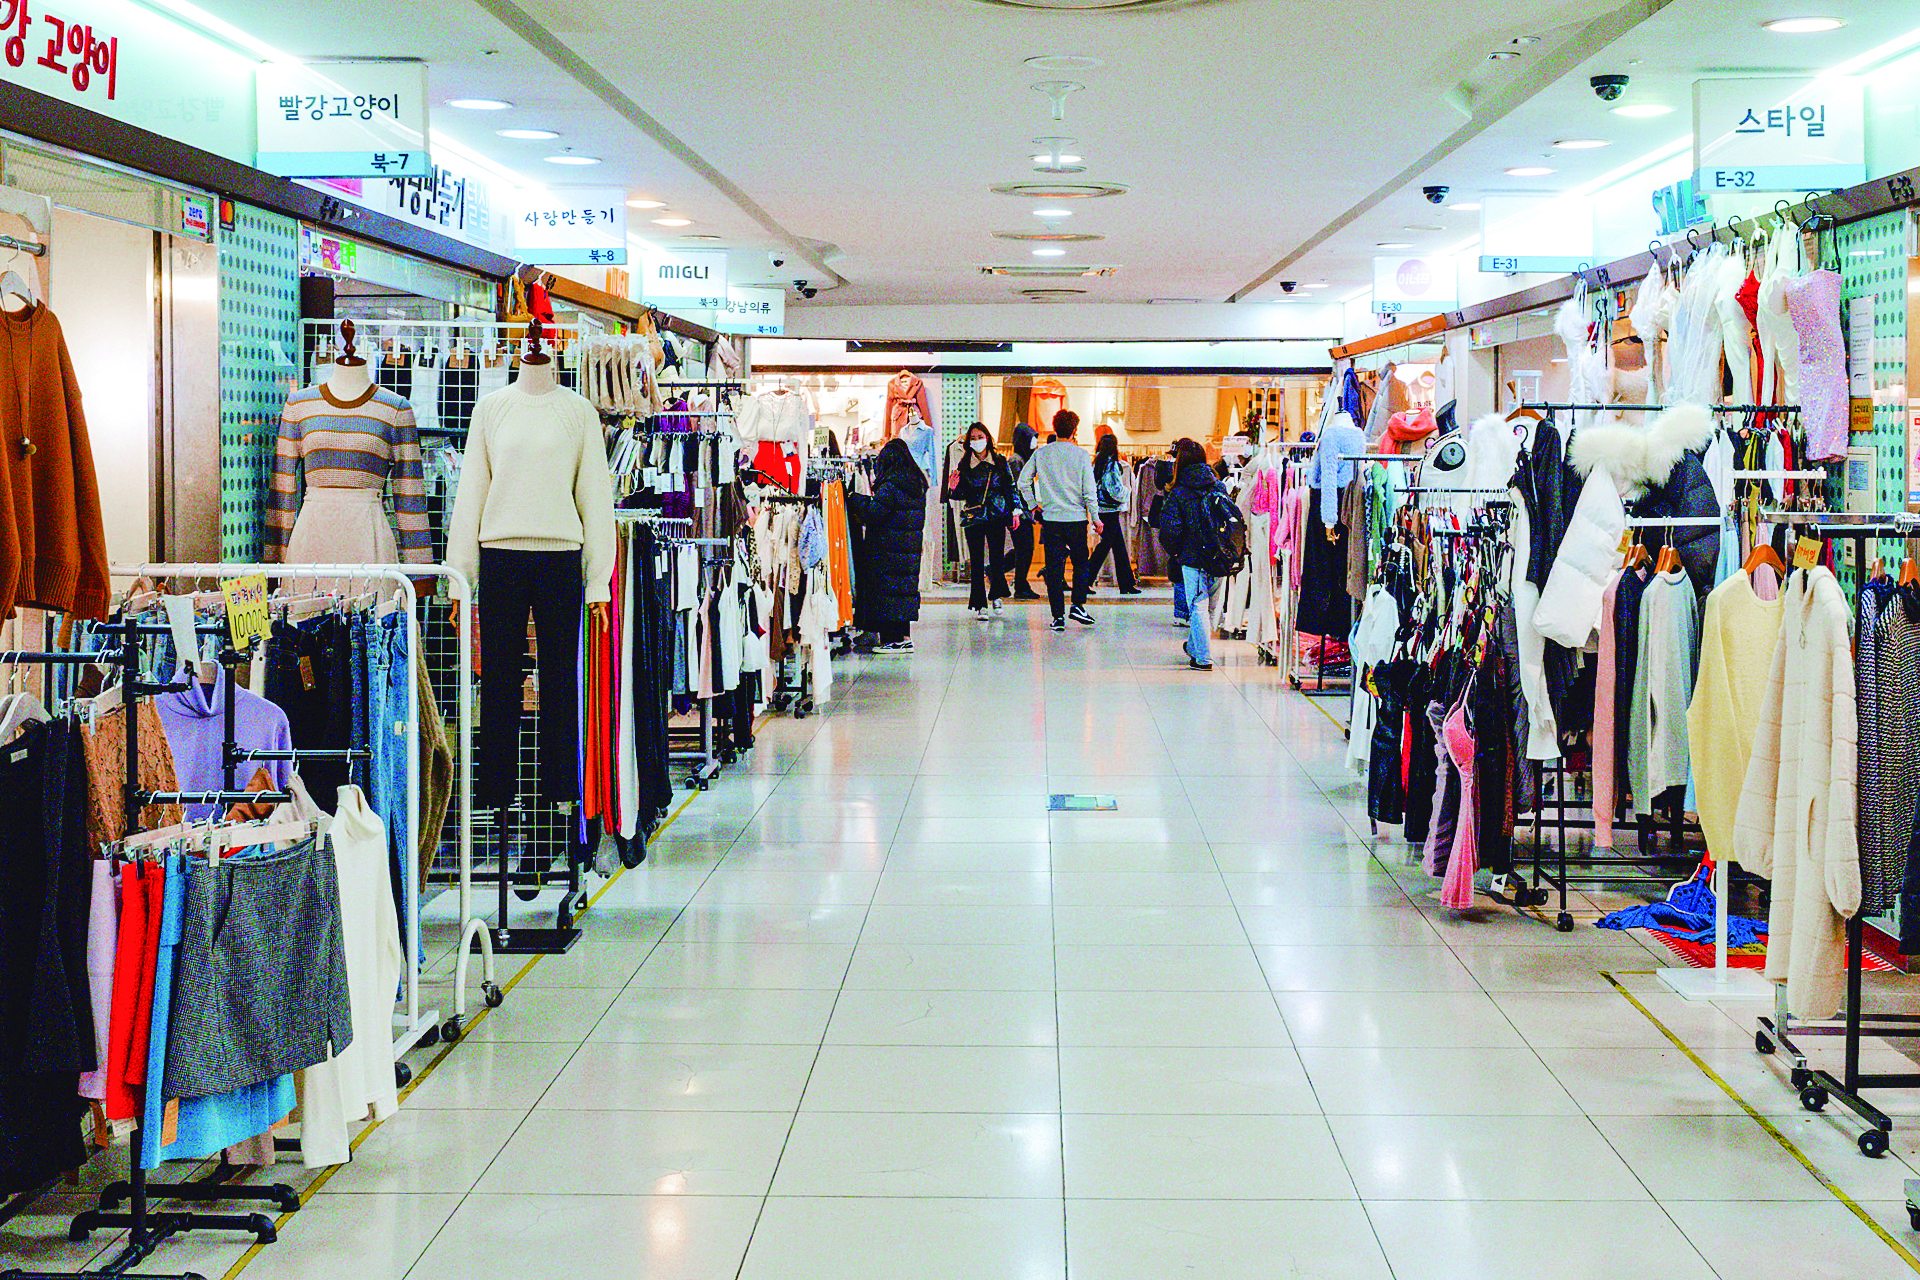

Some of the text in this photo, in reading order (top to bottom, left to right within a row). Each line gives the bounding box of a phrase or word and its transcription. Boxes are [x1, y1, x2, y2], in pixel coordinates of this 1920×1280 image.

[38, 15, 117, 100] 고양이
[279, 94, 399, 121] 빨강고양이
[1735, 105, 1825, 138] 스타일
[371, 153, 409, 173] 북-7
[1716, 171, 1755, 188] E-32
[525, 208, 615, 226] 사랑만들기
[589, 249, 615, 263] 북-8
[1493, 258, 1518, 269] E-31
[659, 265, 709, 279] MIGLI
[698, 297, 718, 308] 북-9
[726, 300, 771, 315] 강남의류
[1382, 303, 1402, 312] E-30
[757, 325, 778, 335] 북-10
